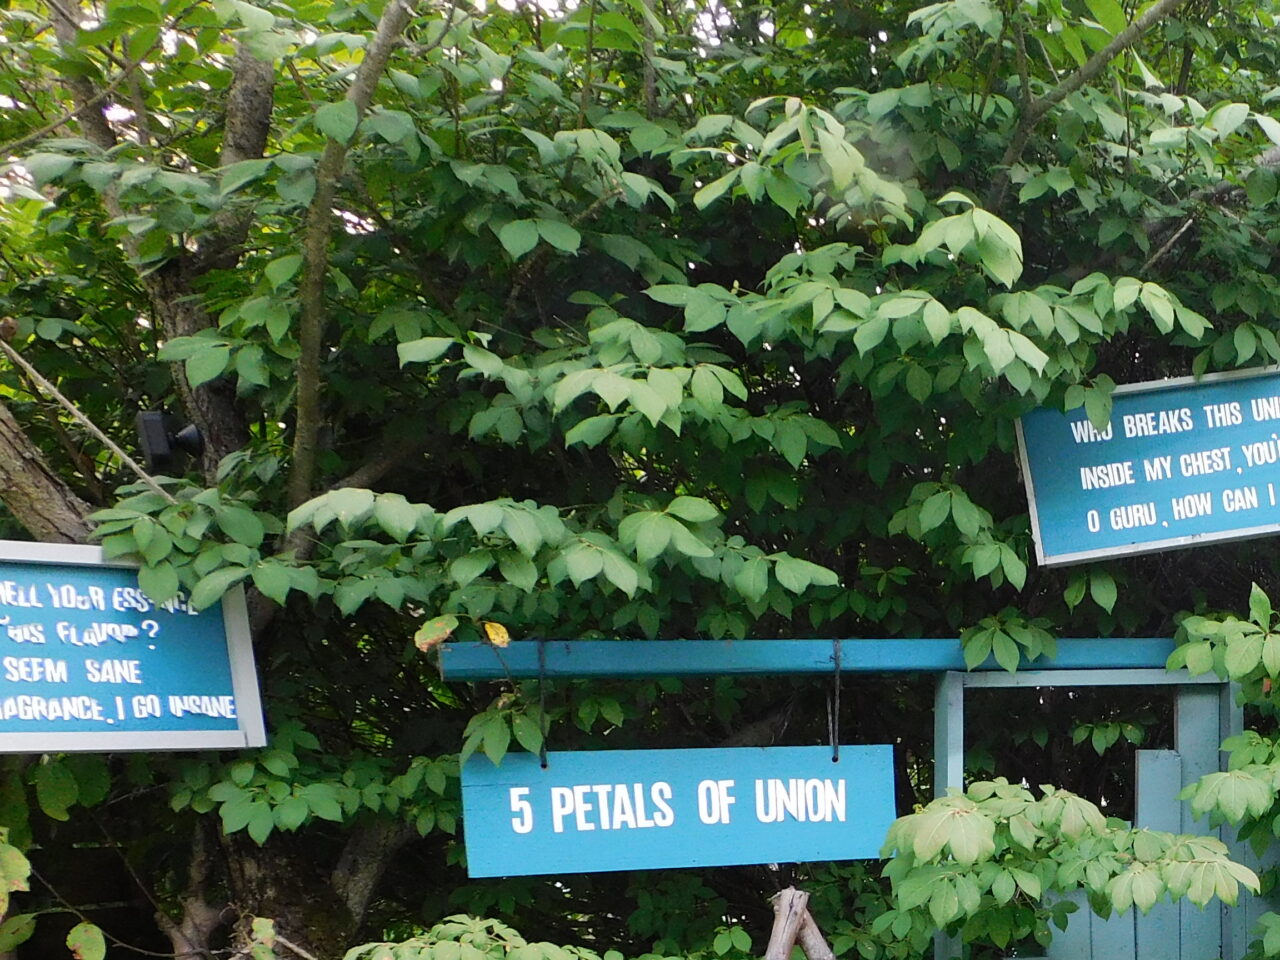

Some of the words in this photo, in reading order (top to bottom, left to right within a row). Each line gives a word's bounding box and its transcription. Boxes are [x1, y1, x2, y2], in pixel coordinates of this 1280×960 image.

[1070, 420, 1113, 443] WHO
[1123, 407, 1194, 438] BREAKS
[1203, 401, 1243, 428] THIS
[1080, 461, 1136, 490] INSIDE
[1143, 455, 1172, 482] MY
[1087, 509, 1101, 533] O
[1171, 491, 1212, 521] HOW
[1222, 486, 1259, 513] CAN
[1267, 483, 1276, 506] I
[112, 587, 199, 615] ESSNCE
[84, 658, 142, 684] SANE
[115, 695, 125, 720] I
[131, 694, 161, 719] GO
[169, 696, 238, 719] INSANE
[509, 786, 534, 834] 5
[550, 781, 675, 833] PETALS
[697, 779, 736, 825] OF
[755, 778, 846, 823] UNION
